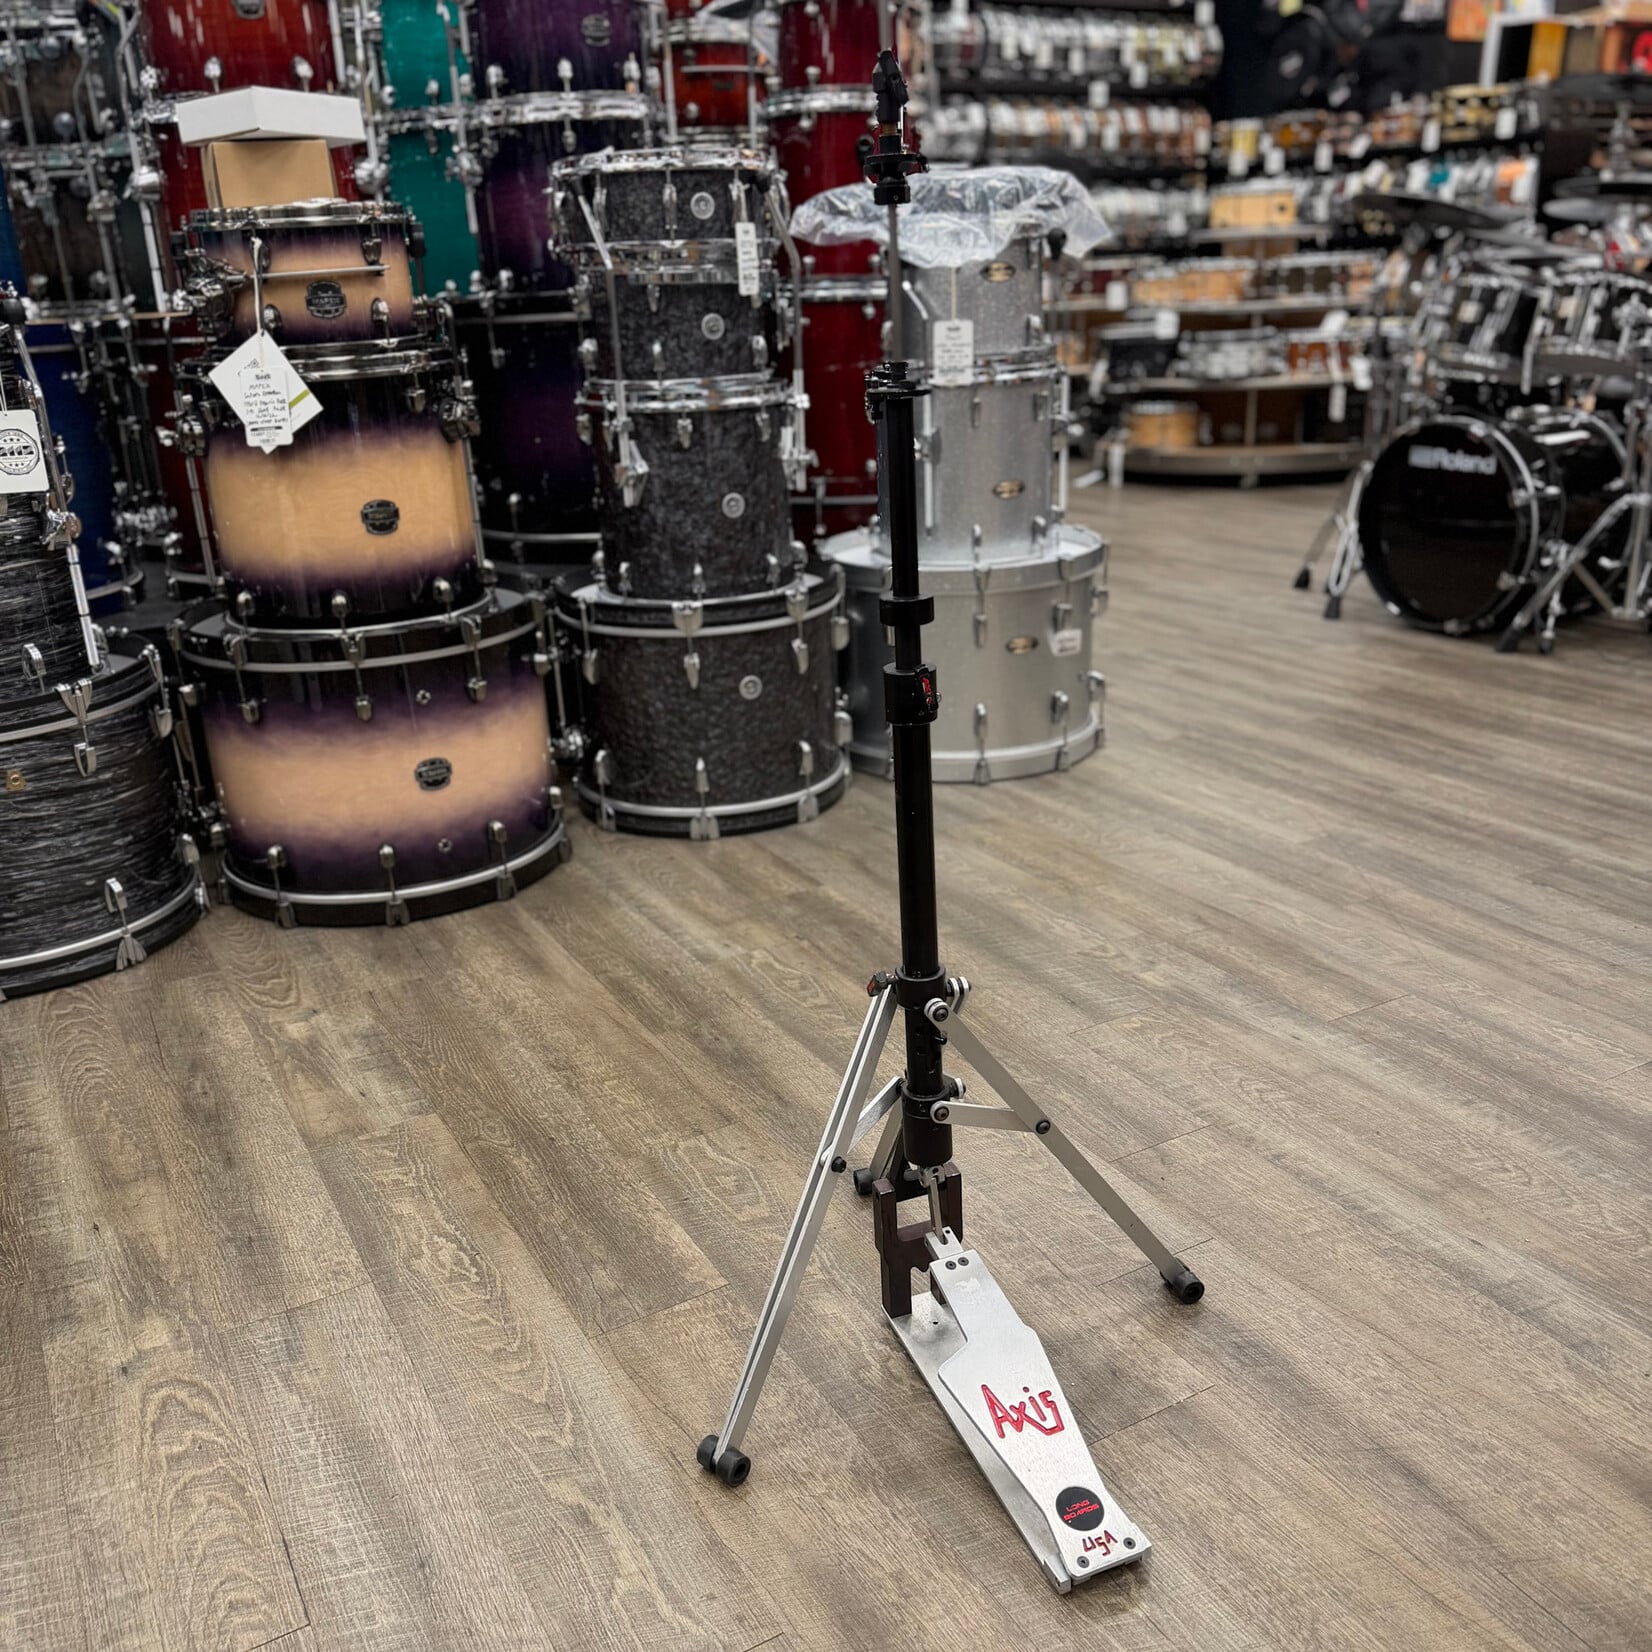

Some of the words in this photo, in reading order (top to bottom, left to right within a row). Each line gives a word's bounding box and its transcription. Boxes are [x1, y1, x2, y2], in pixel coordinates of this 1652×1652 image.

[1432, 447, 1498, 475] Roland
[981, 1384, 1065, 1439] Axis
[1063, 1503, 1100, 1521] BOARDS
[1066, 1500, 1090, 1512] LONG
[1082, 1530, 1119, 1557] USA
